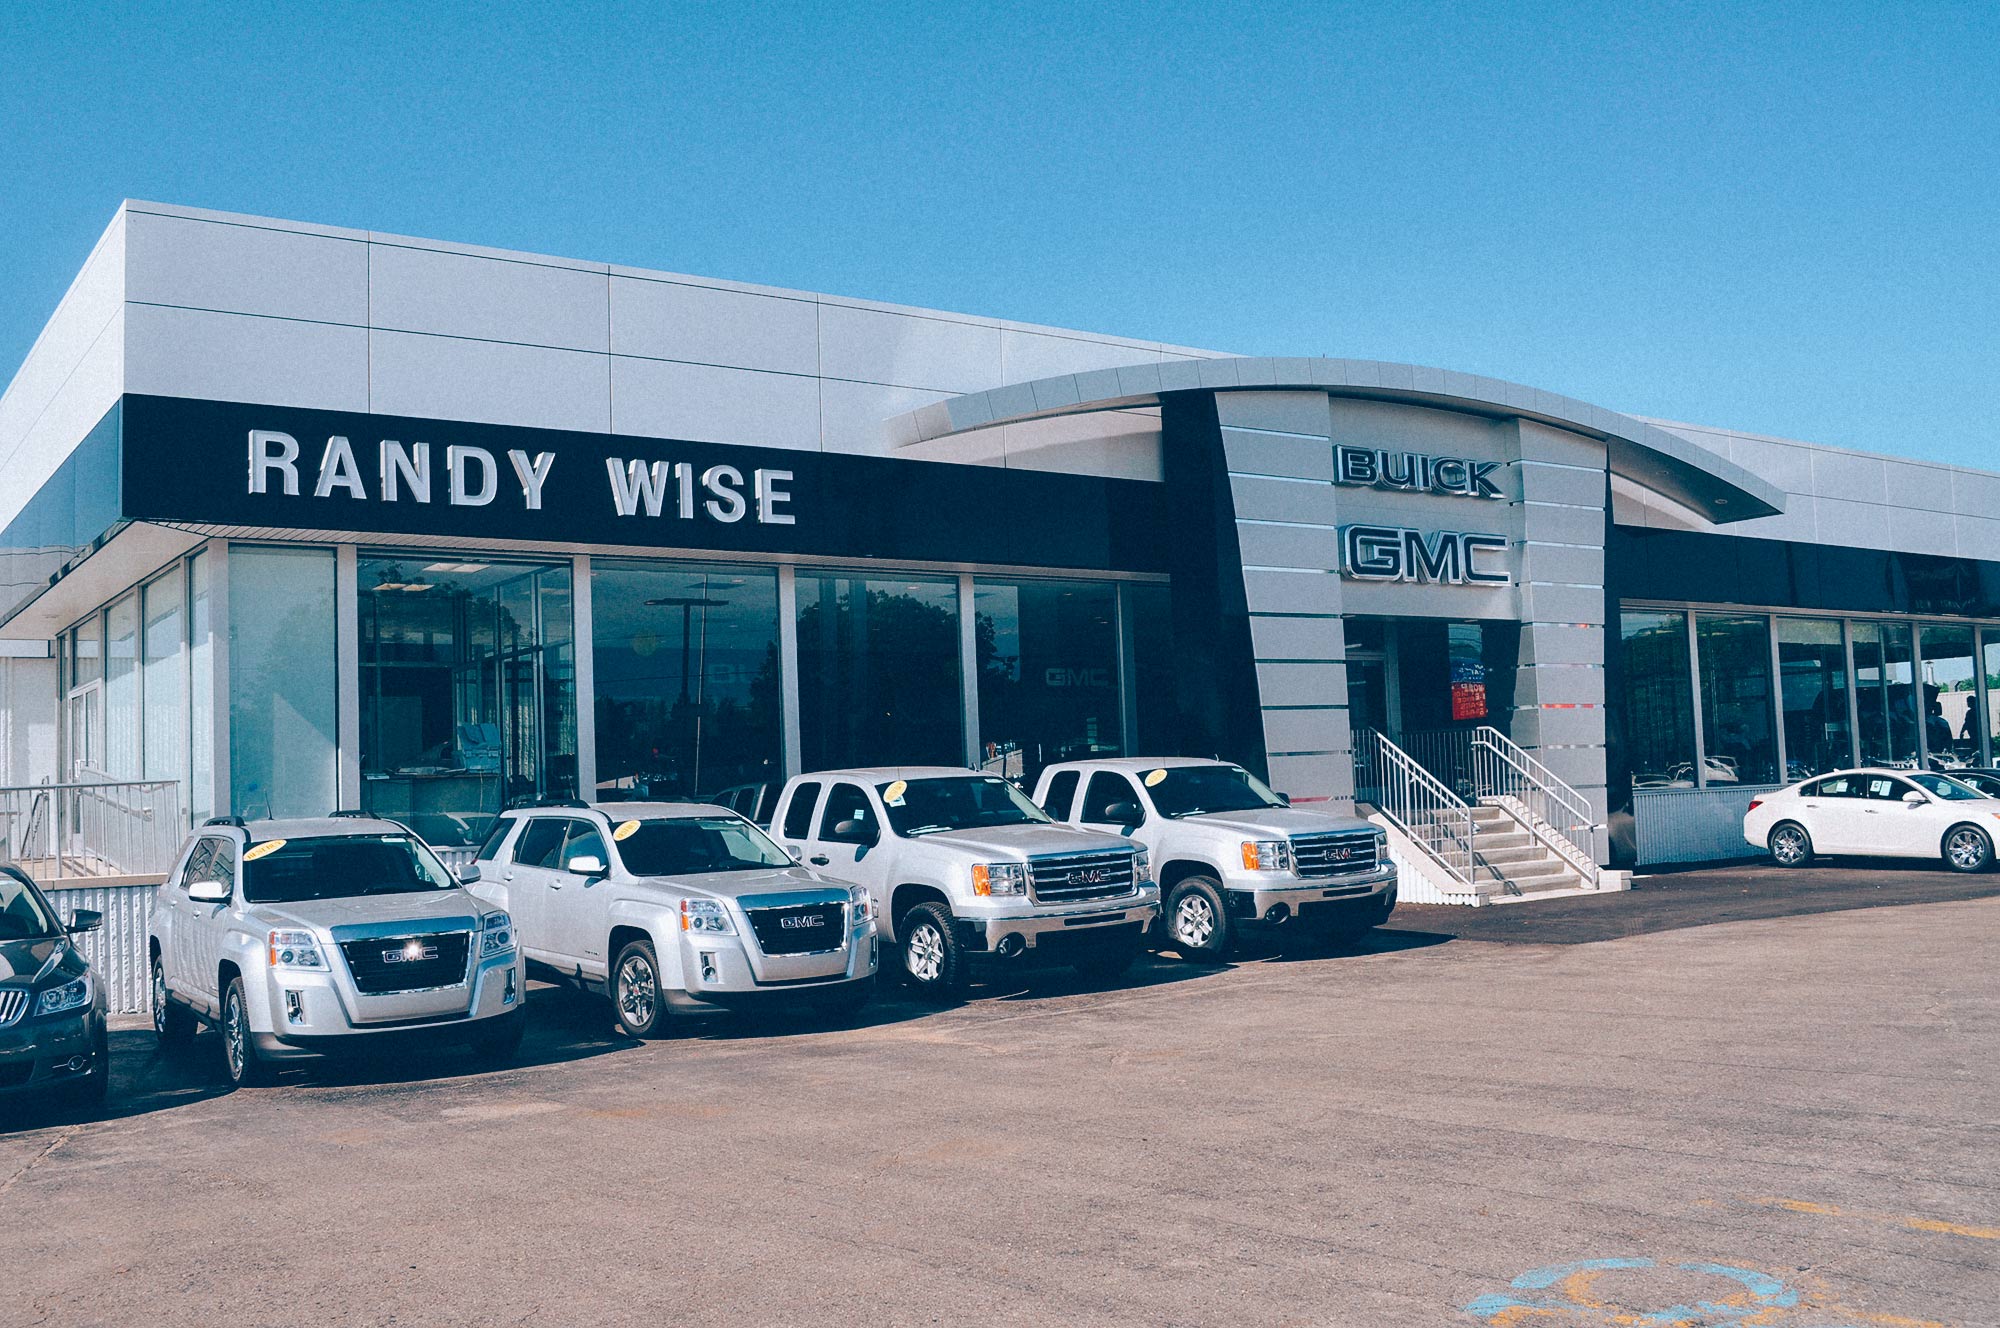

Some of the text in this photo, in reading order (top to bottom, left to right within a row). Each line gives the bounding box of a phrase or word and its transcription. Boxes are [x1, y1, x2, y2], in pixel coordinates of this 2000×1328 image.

[247, 429, 796, 525] RANDY WISE
[1332, 443, 1507, 499] BUICK
[1338, 524, 1512, 587] GMC
[1045, 667, 1110, 687] GMC
[1322, 846, 1360, 861] GMC
[1066, 868, 1111, 885] GMC
[780, 914, 824, 929] GMC
